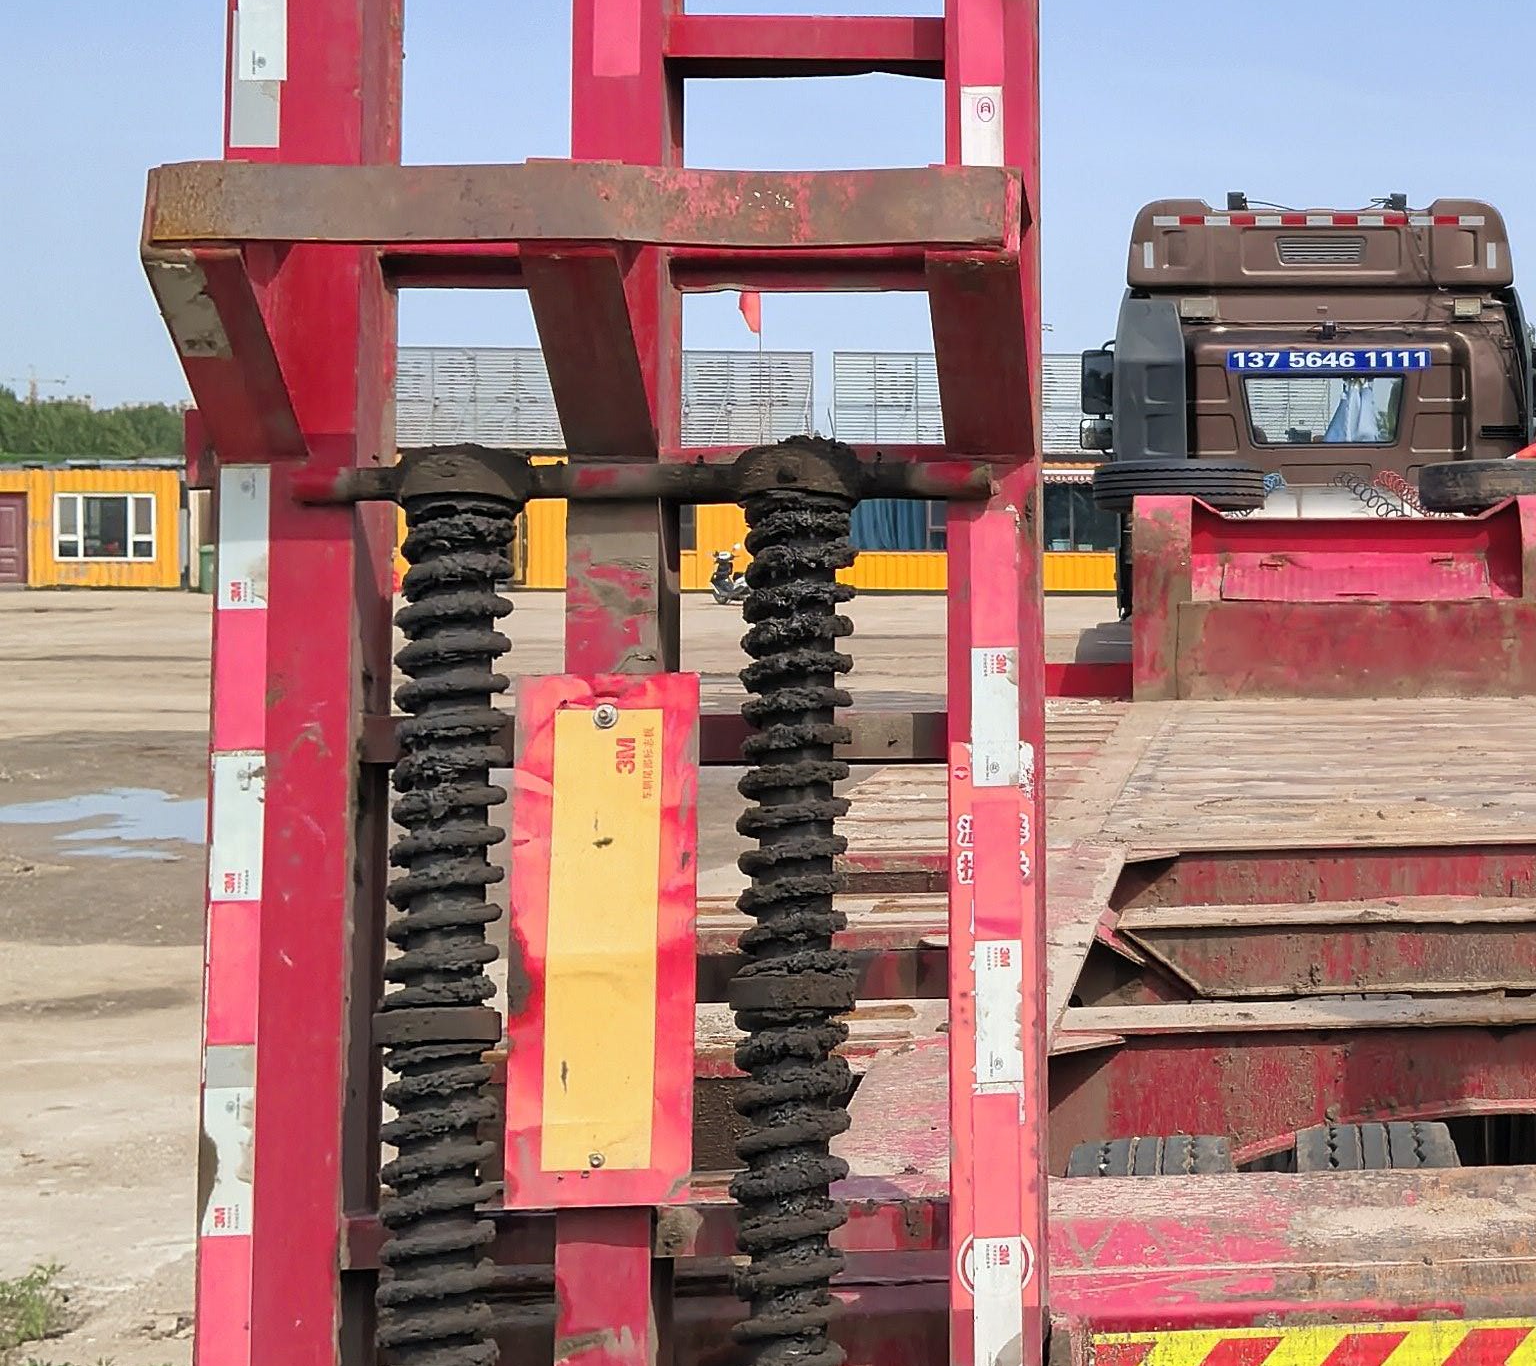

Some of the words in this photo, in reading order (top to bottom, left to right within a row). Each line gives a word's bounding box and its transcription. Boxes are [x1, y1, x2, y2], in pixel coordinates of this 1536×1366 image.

[1233, 352, 1280, 368] 137
[1289, 352, 1356, 368] 5646
[1364, 352, 1426, 368] 1111
[230, 581, 241, 602] 3M
[995, 654, 1007, 675] 3M
[615, 737, 636, 774] 3M
[224, 872, 235, 894] 3M
[998, 947, 1010, 967] 3M
[213, 1207, 225, 1228] 3M
[998, 1244, 1010, 1266] 3M
